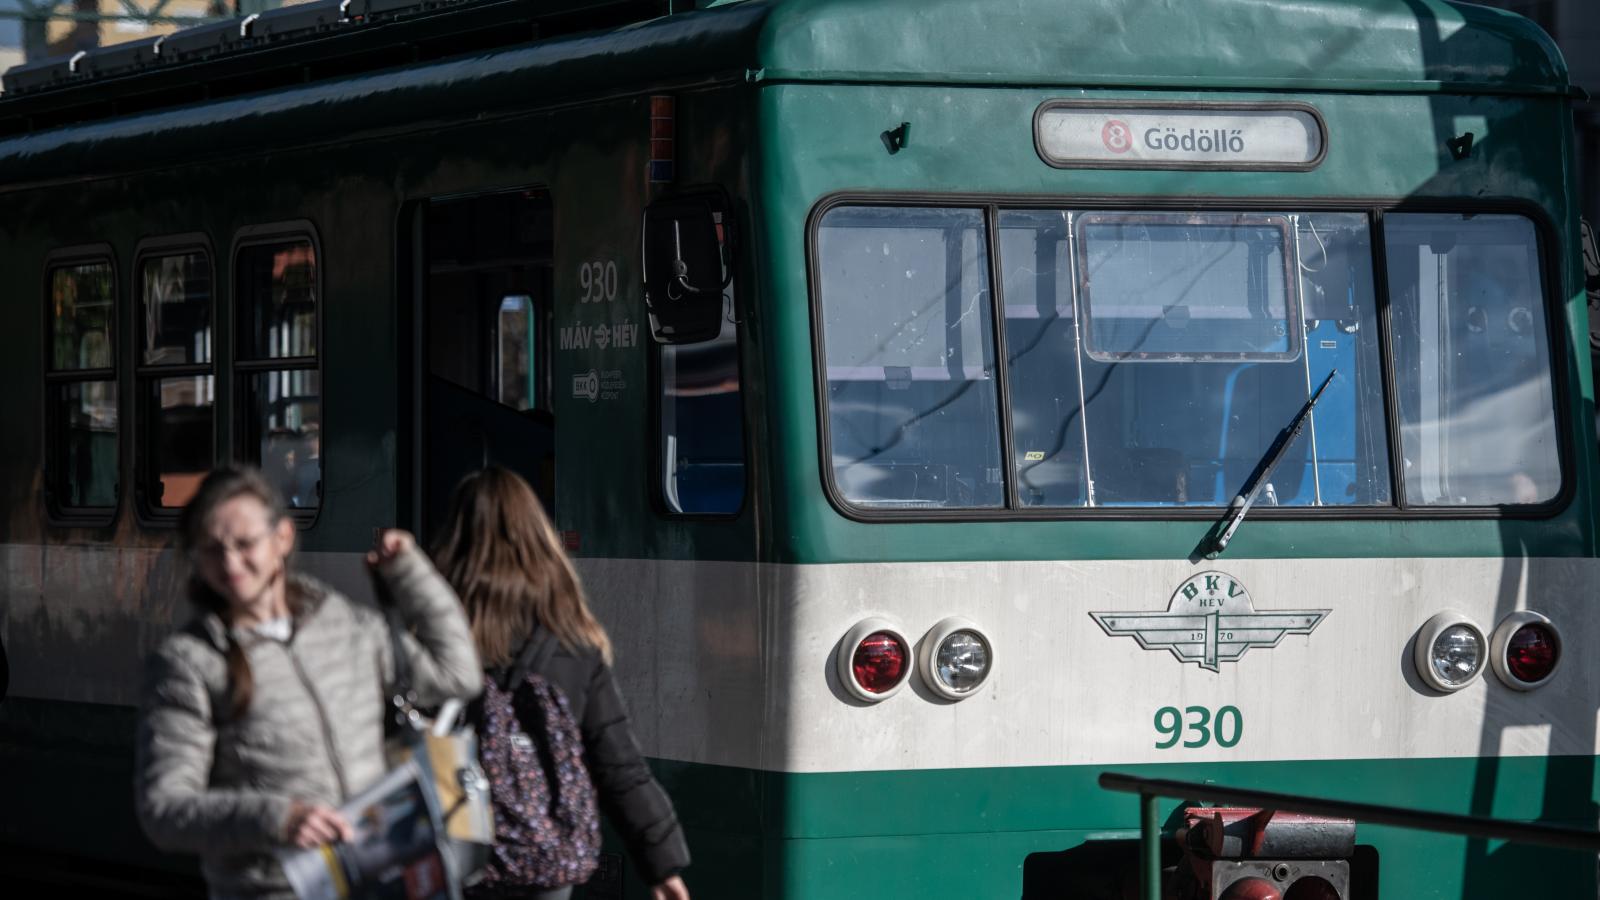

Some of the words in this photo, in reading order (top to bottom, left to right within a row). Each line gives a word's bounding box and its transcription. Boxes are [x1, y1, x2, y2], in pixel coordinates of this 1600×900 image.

[1110, 125, 1125, 147] 8
[1144, 126, 1244, 152] Gödöllő
[580, 260, 618, 303] 930
[560, 321, 593, 350] MÁV
[612, 319, 638, 348] HÉV
[1181, 575, 1245, 602] BKV
[1153, 706, 1244, 748] 930
